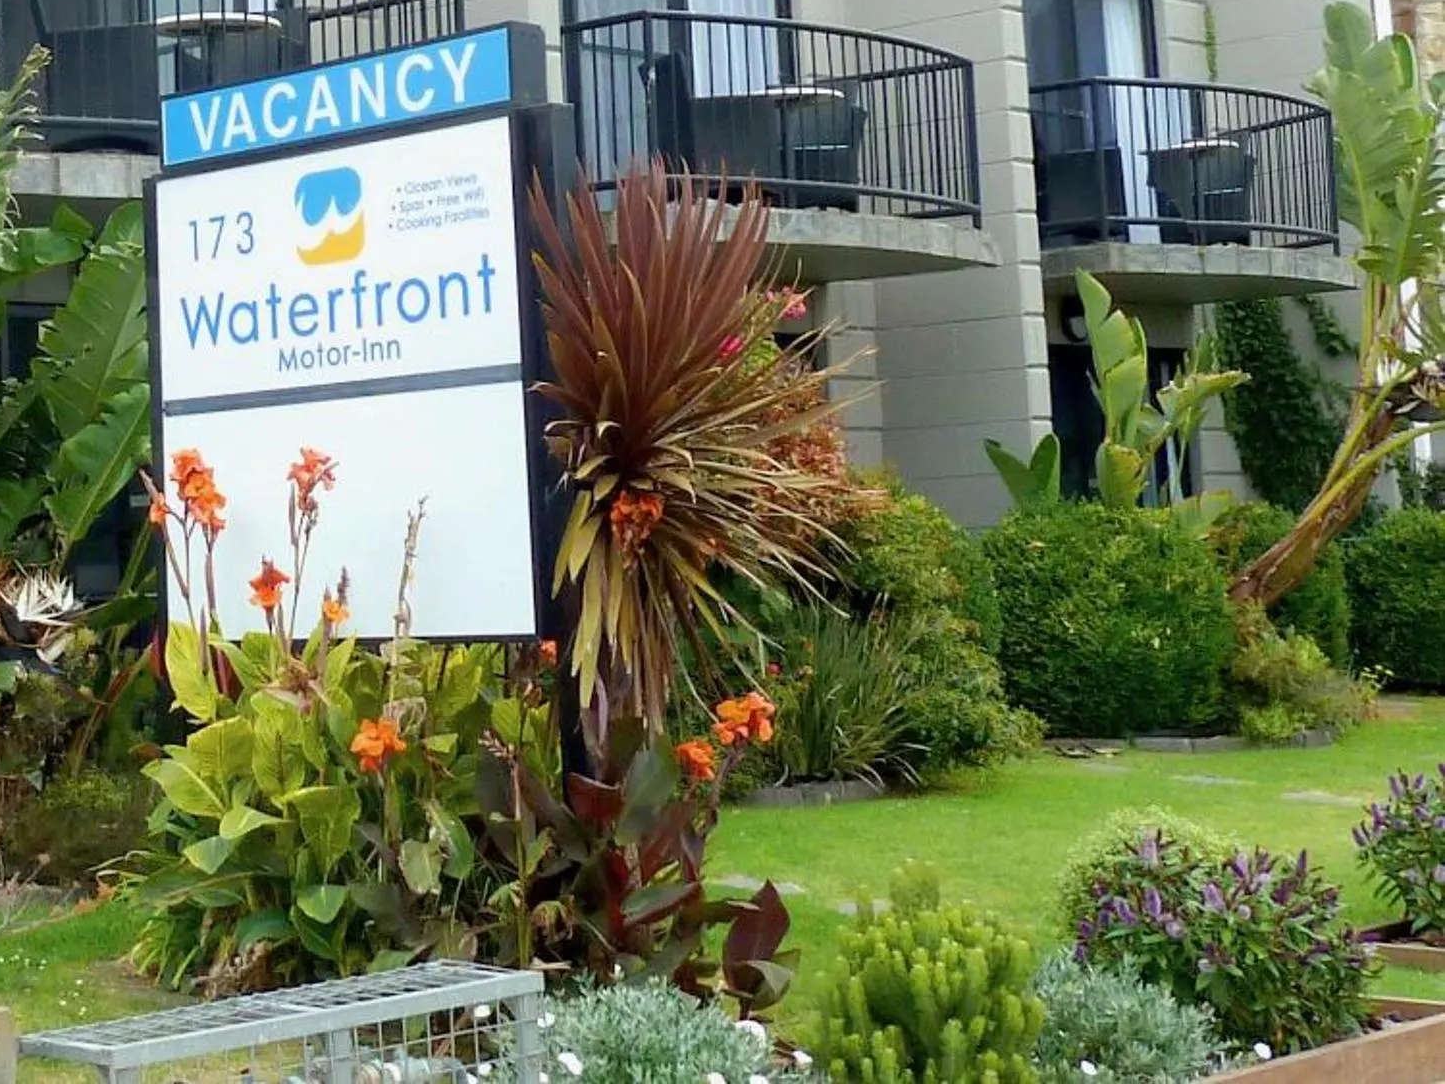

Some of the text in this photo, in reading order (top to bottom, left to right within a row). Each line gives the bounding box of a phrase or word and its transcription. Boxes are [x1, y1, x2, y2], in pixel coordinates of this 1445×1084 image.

[188, 42, 477, 152] VACANCY
[188, 211, 255, 262] 173
[179, 253, 497, 350] Waterfront
[278, 337, 402, 372] Motor-Inn
